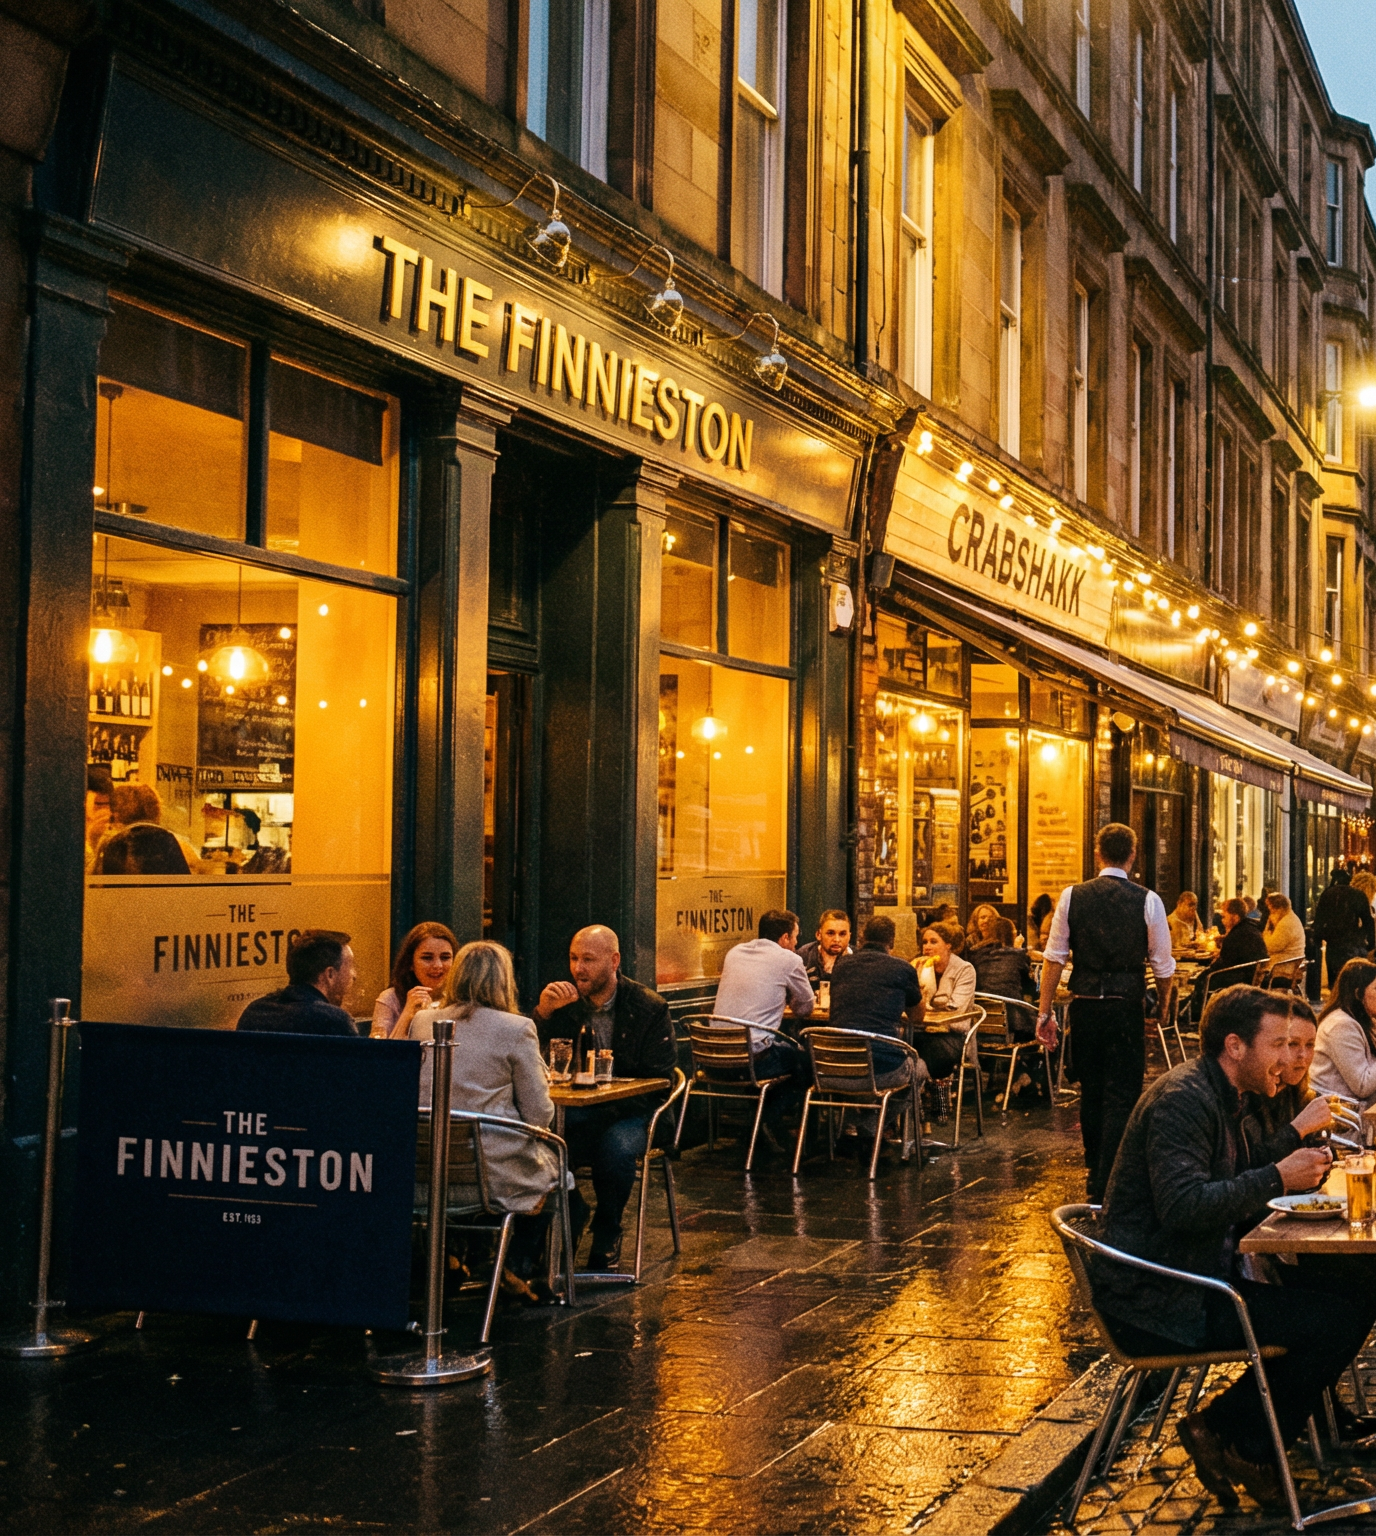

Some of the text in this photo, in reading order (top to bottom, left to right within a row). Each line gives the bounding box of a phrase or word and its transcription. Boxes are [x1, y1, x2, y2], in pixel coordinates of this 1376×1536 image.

[381, 235, 754, 471] THE FINNIESTON
[947, 503, 1087, 617] CRABSHAKK
[228, 904, 256, 923] THE
[708, 889, 724, 903] THE
[676, 907, 753, 934] FINNIESTON
[154, 929, 301, 973] FINNIEST
[223, 1111, 267, 1135] THE
[117, 1136, 373, 1193] FINNIESTON
